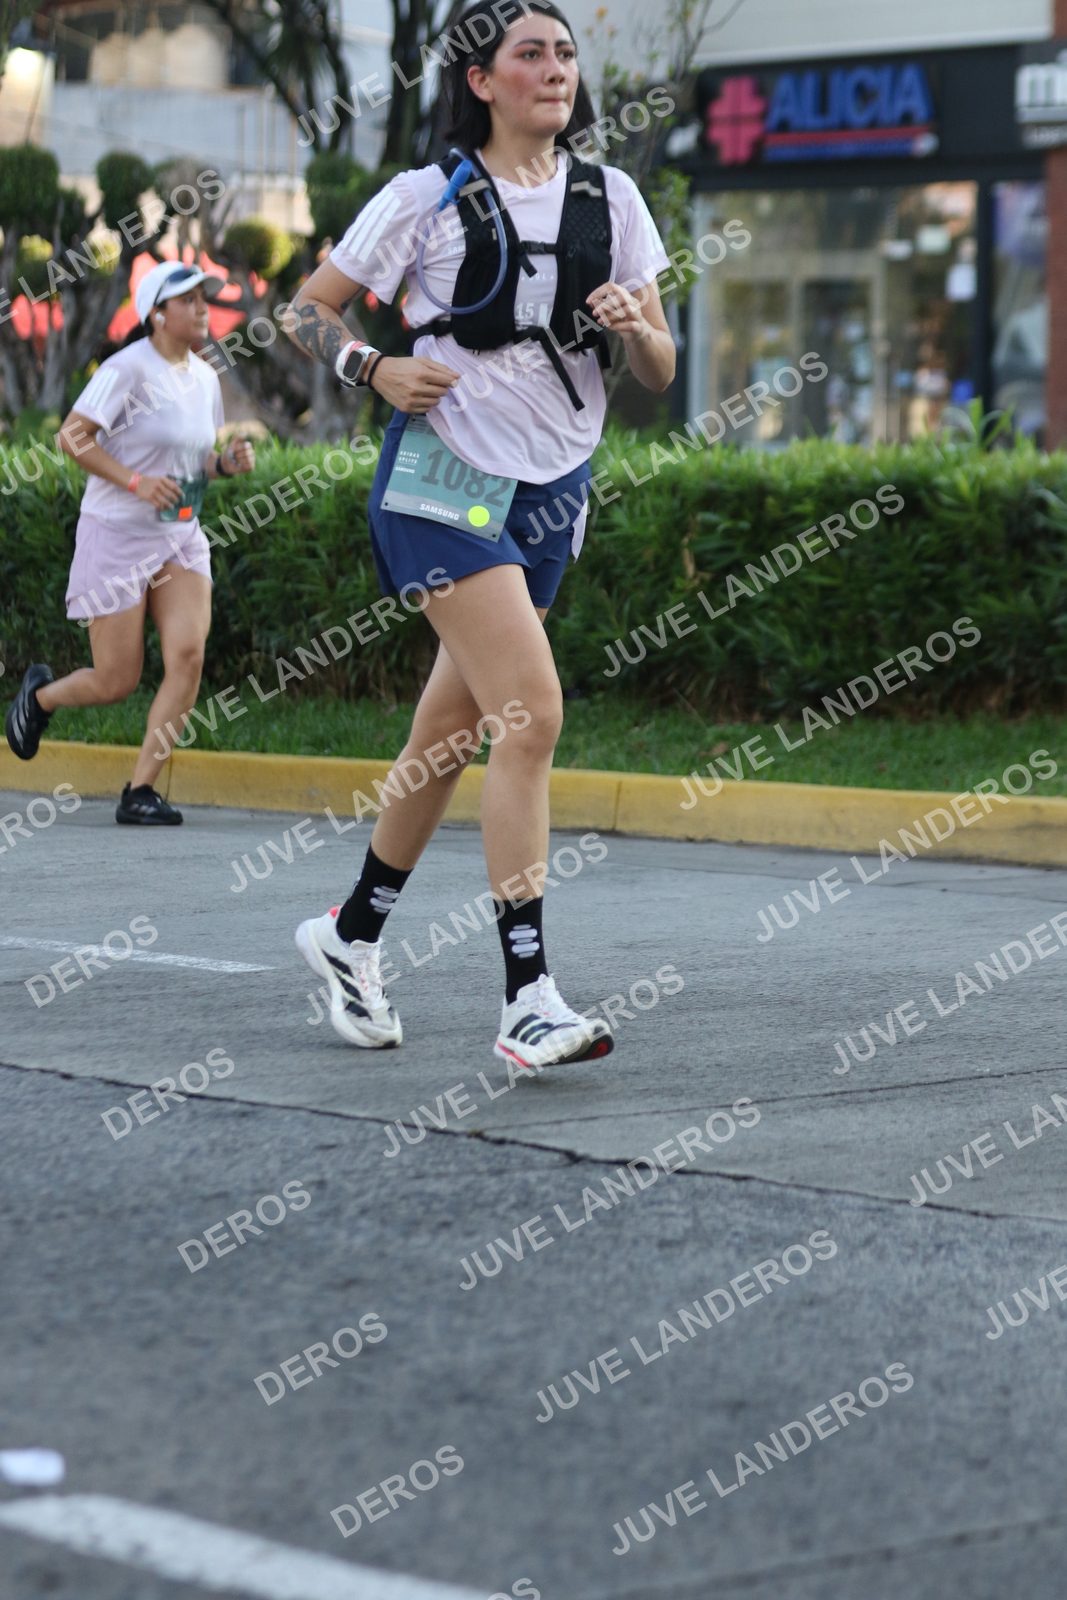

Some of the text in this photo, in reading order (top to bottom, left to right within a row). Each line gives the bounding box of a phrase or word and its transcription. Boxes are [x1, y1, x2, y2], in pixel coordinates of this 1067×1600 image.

[764, 62, 934, 132] ALICIA
[421, 448, 511, 508] 1082
[419, 503, 460, 521] SAMSUNG
